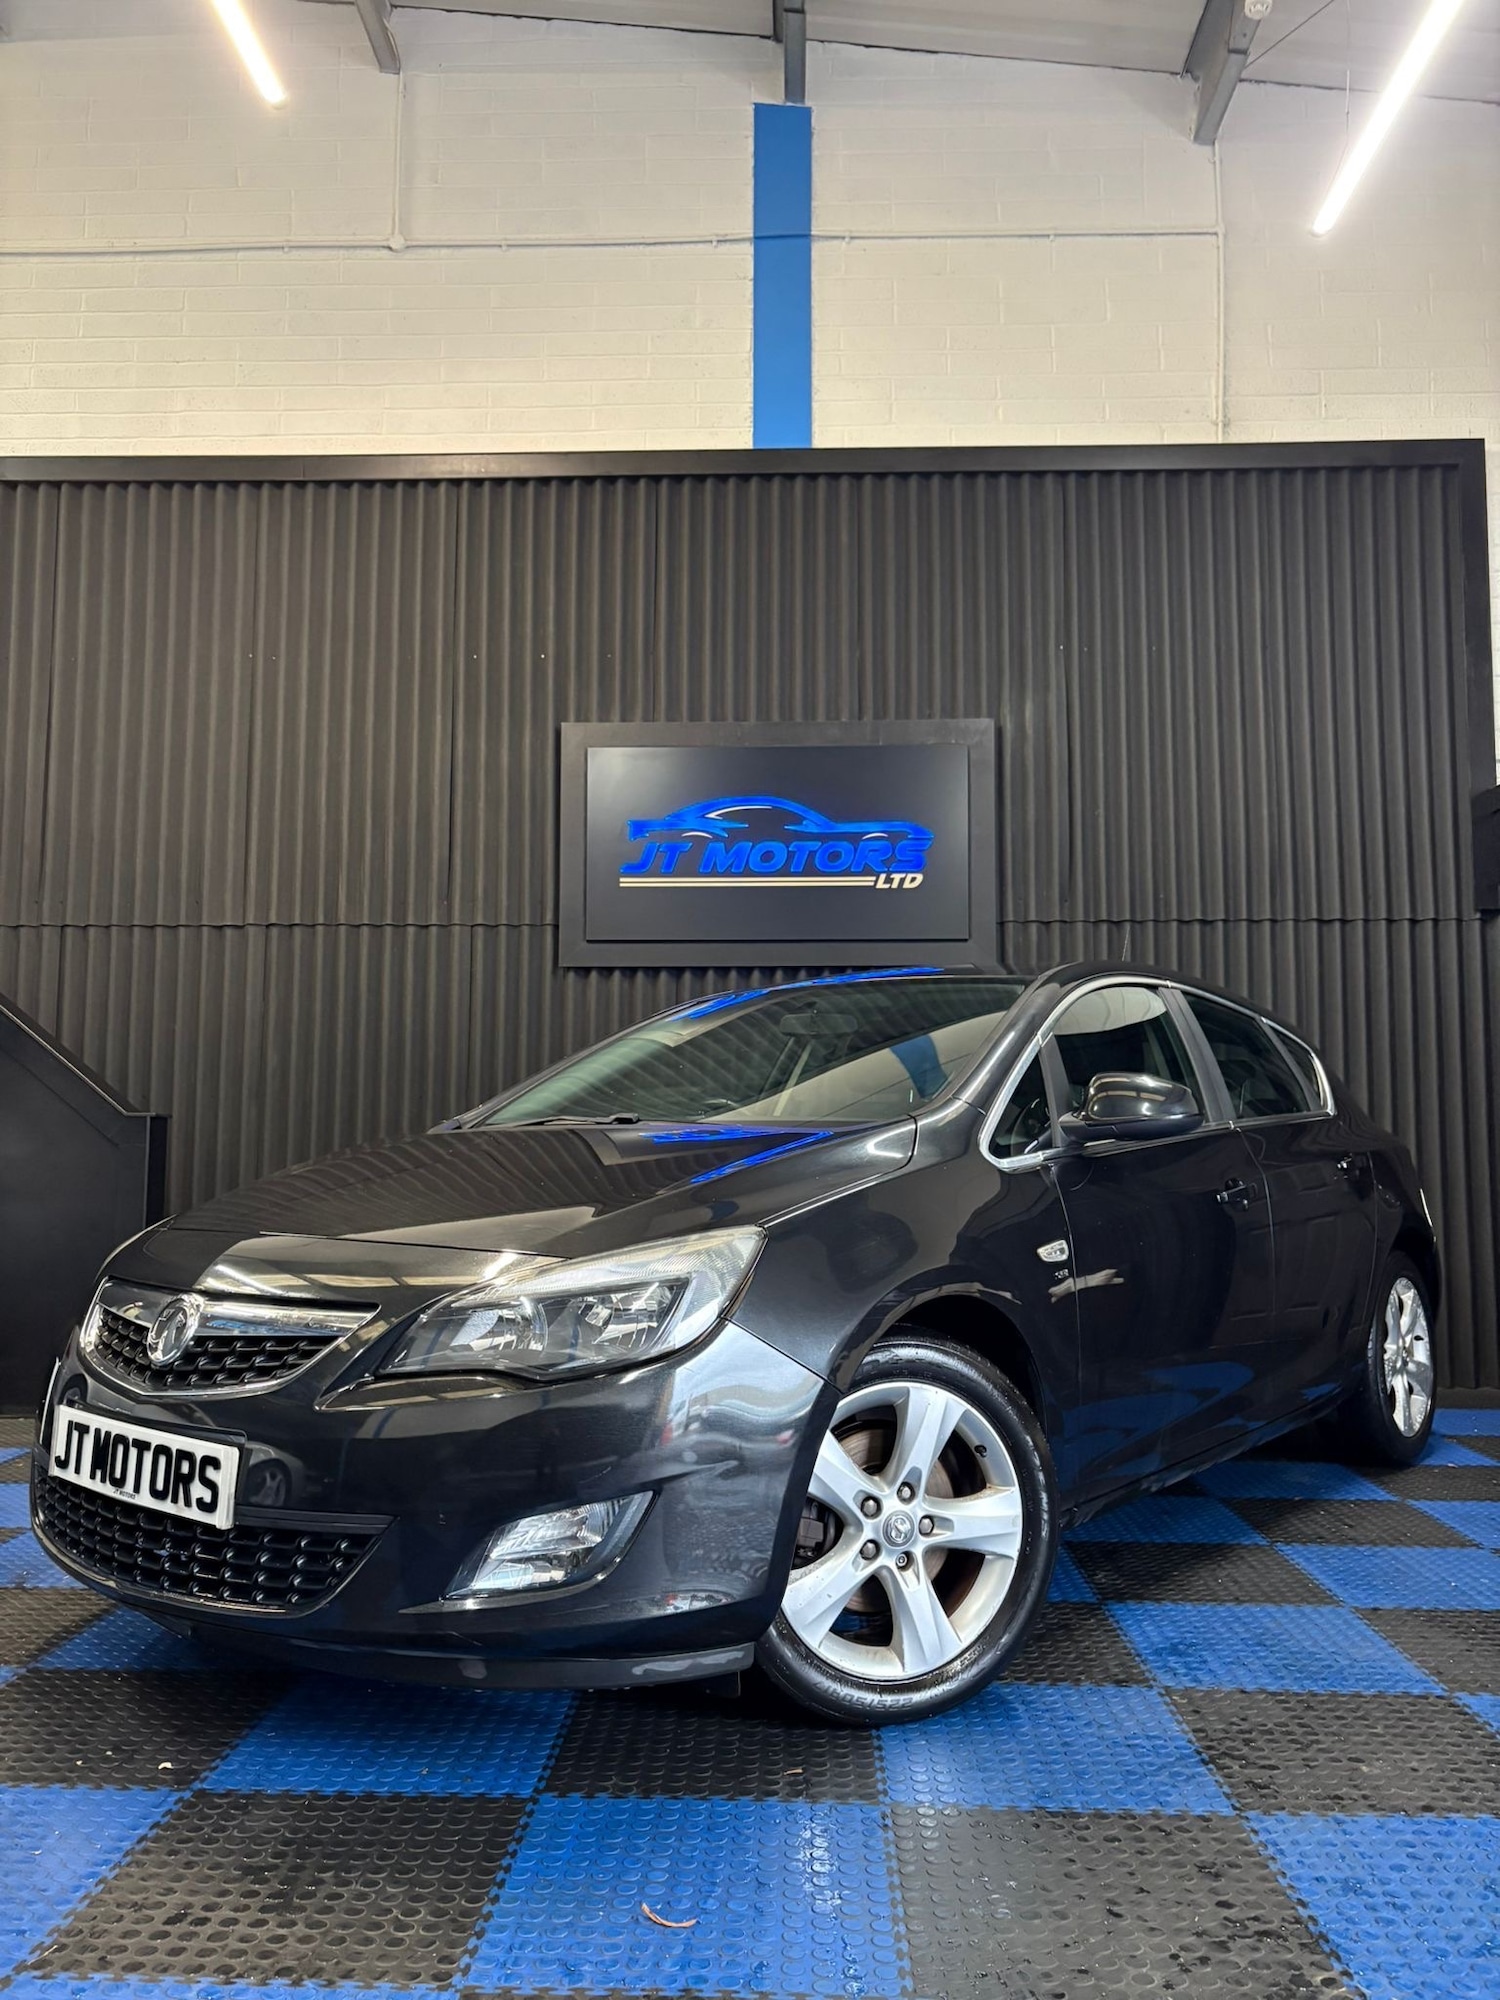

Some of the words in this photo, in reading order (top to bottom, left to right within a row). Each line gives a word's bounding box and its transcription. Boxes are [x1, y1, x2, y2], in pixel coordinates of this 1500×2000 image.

[619, 842, 692, 874] JT
[699, 839, 934, 873] MOTORS
[875, 873, 924, 889] LTD
[55, 1420, 90, 1474] JT
[90, 1428, 221, 1513] MOTORS
